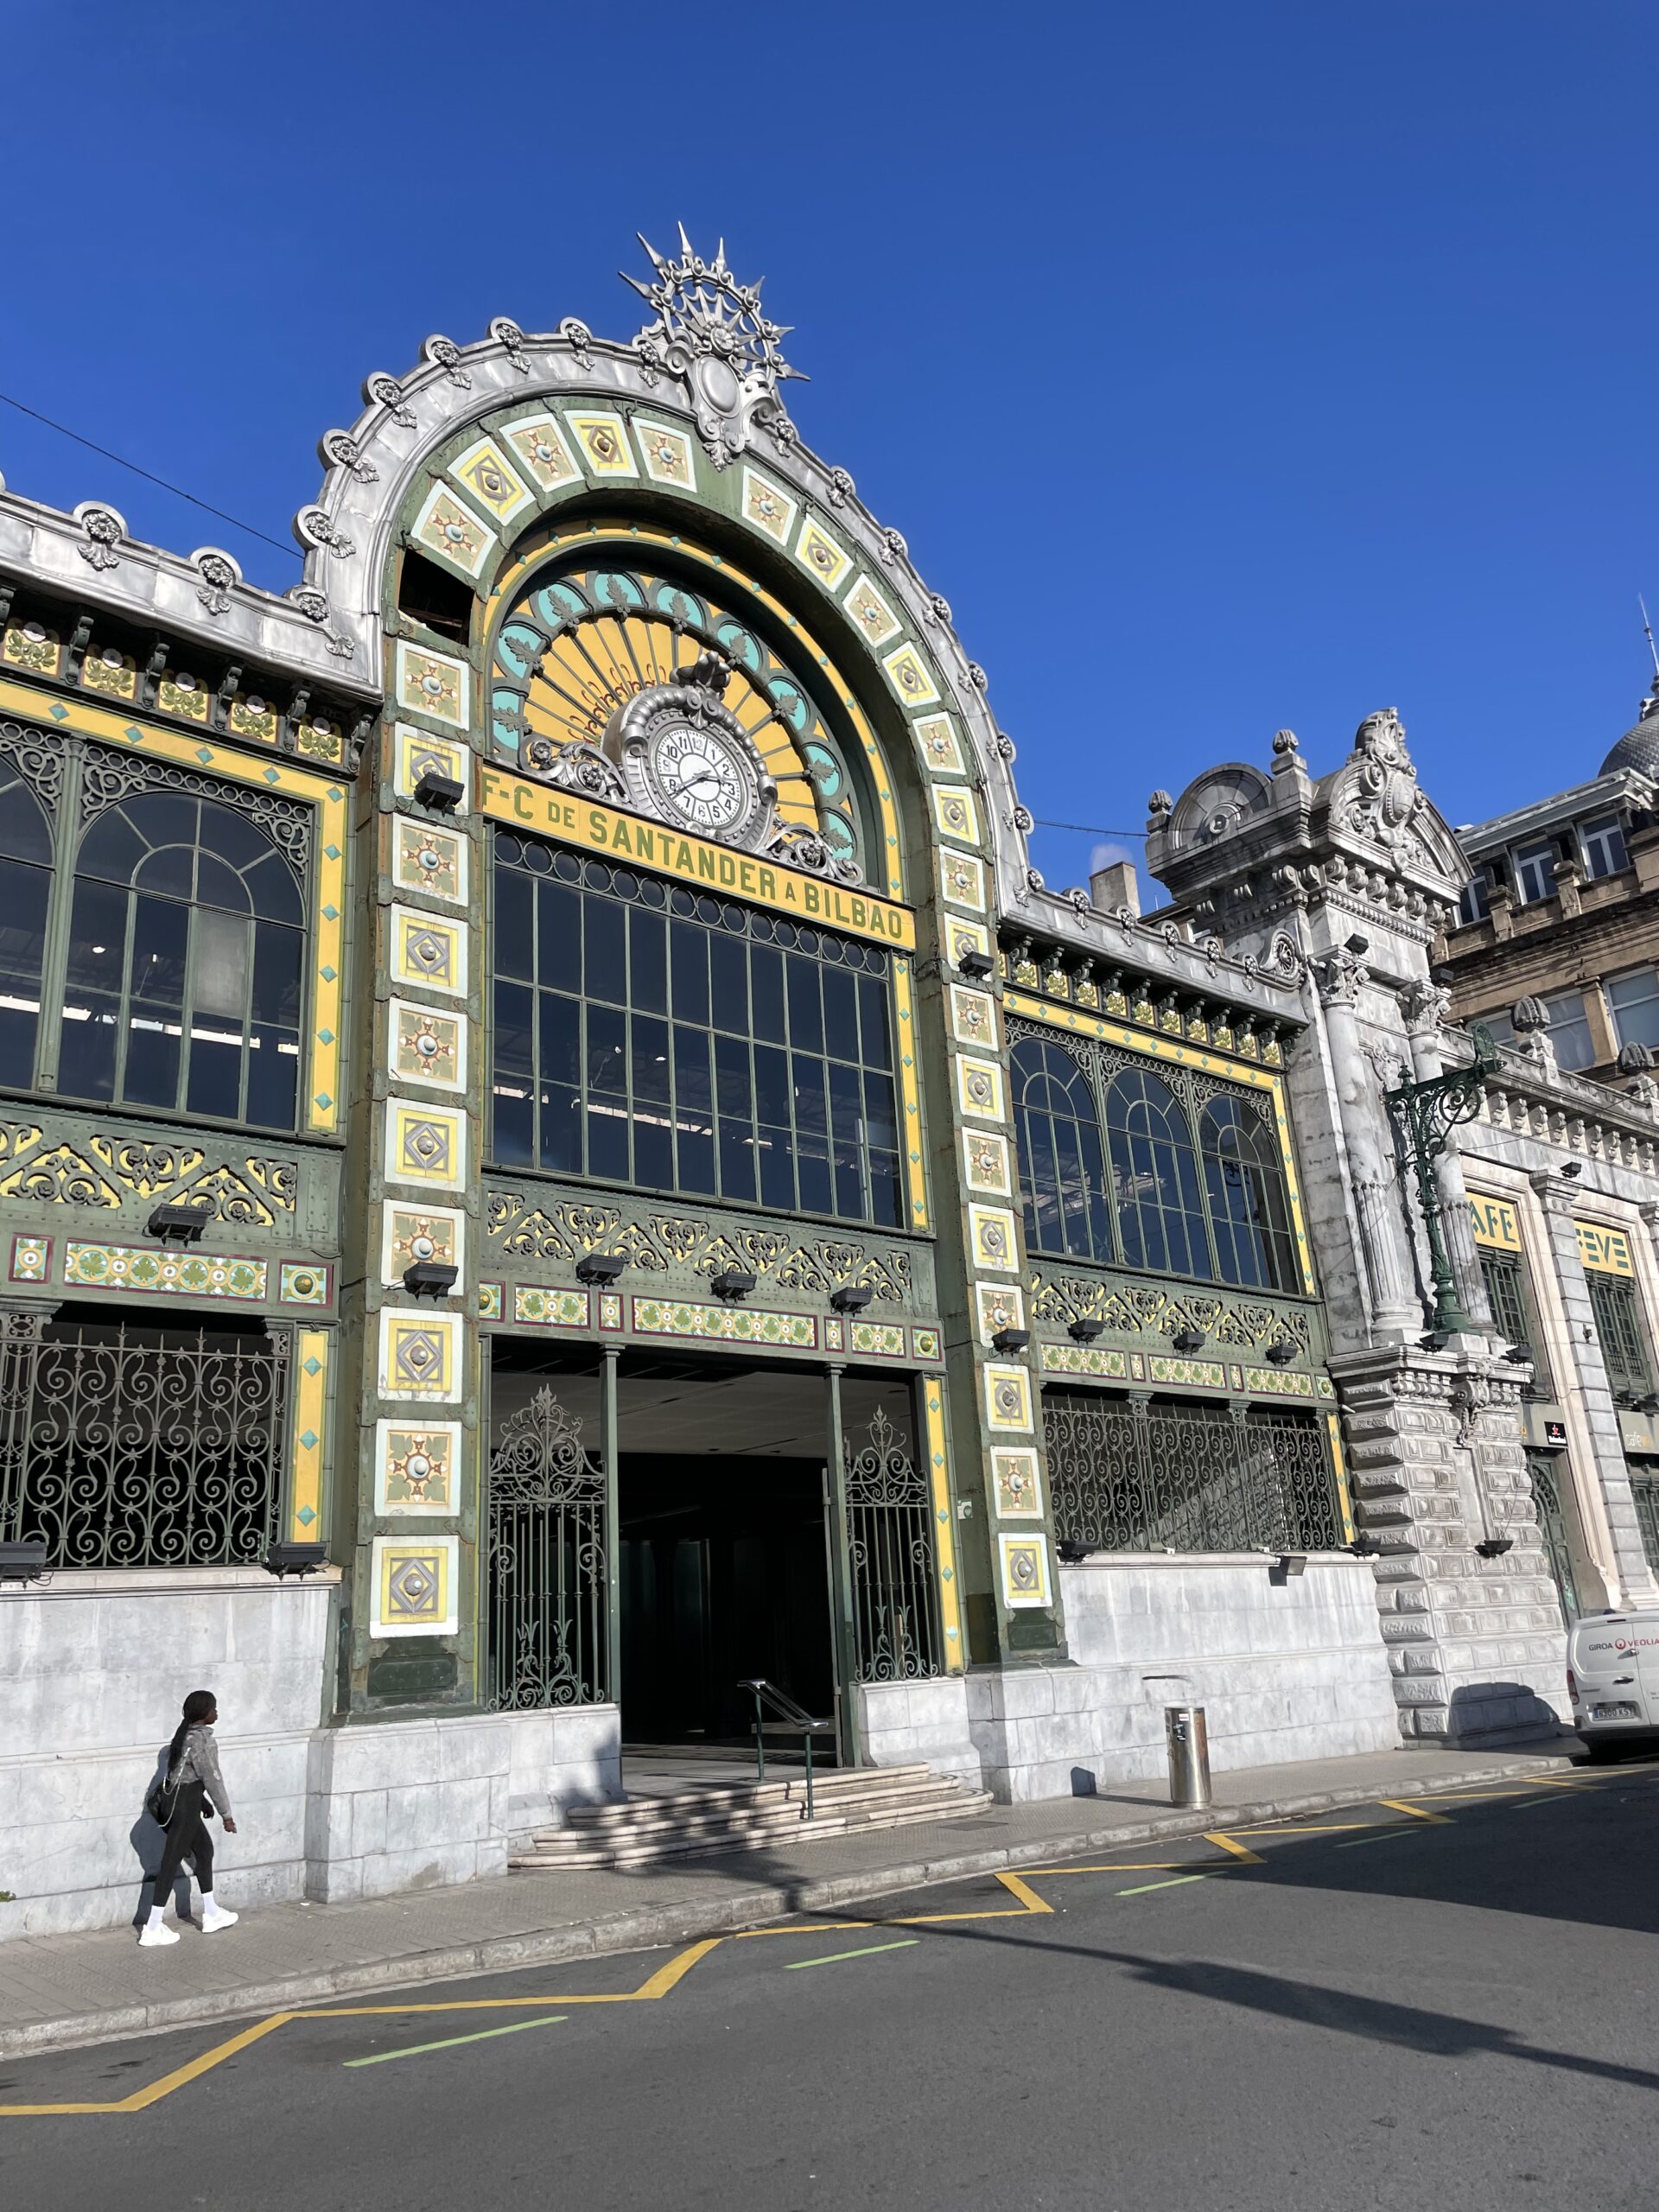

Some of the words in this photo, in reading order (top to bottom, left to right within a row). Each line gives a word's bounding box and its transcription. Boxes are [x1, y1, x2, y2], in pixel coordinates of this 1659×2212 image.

[678, 736, 688, 750] 11
[692, 737, 703, 752] 12
[666, 745, 678, 759] 10
[663, 760, 671, 772] 9
[722, 763, 730, 776] 2
[669, 779, 677, 791] 8
[725, 782, 735, 795] 3
[683, 795, 690, 808] 7
[724, 798, 732, 810] 4
[698, 804, 706, 817] 6
[712, 805, 721, 818] 5
[548, 801, 575, 829] DE
[589, 810, 776, 900] SANTANDER
[785, 882, 796, 901] A
[804, 882, 902, 938] BILBAO
[1589, 1643, 1613, 1651] GIROA
